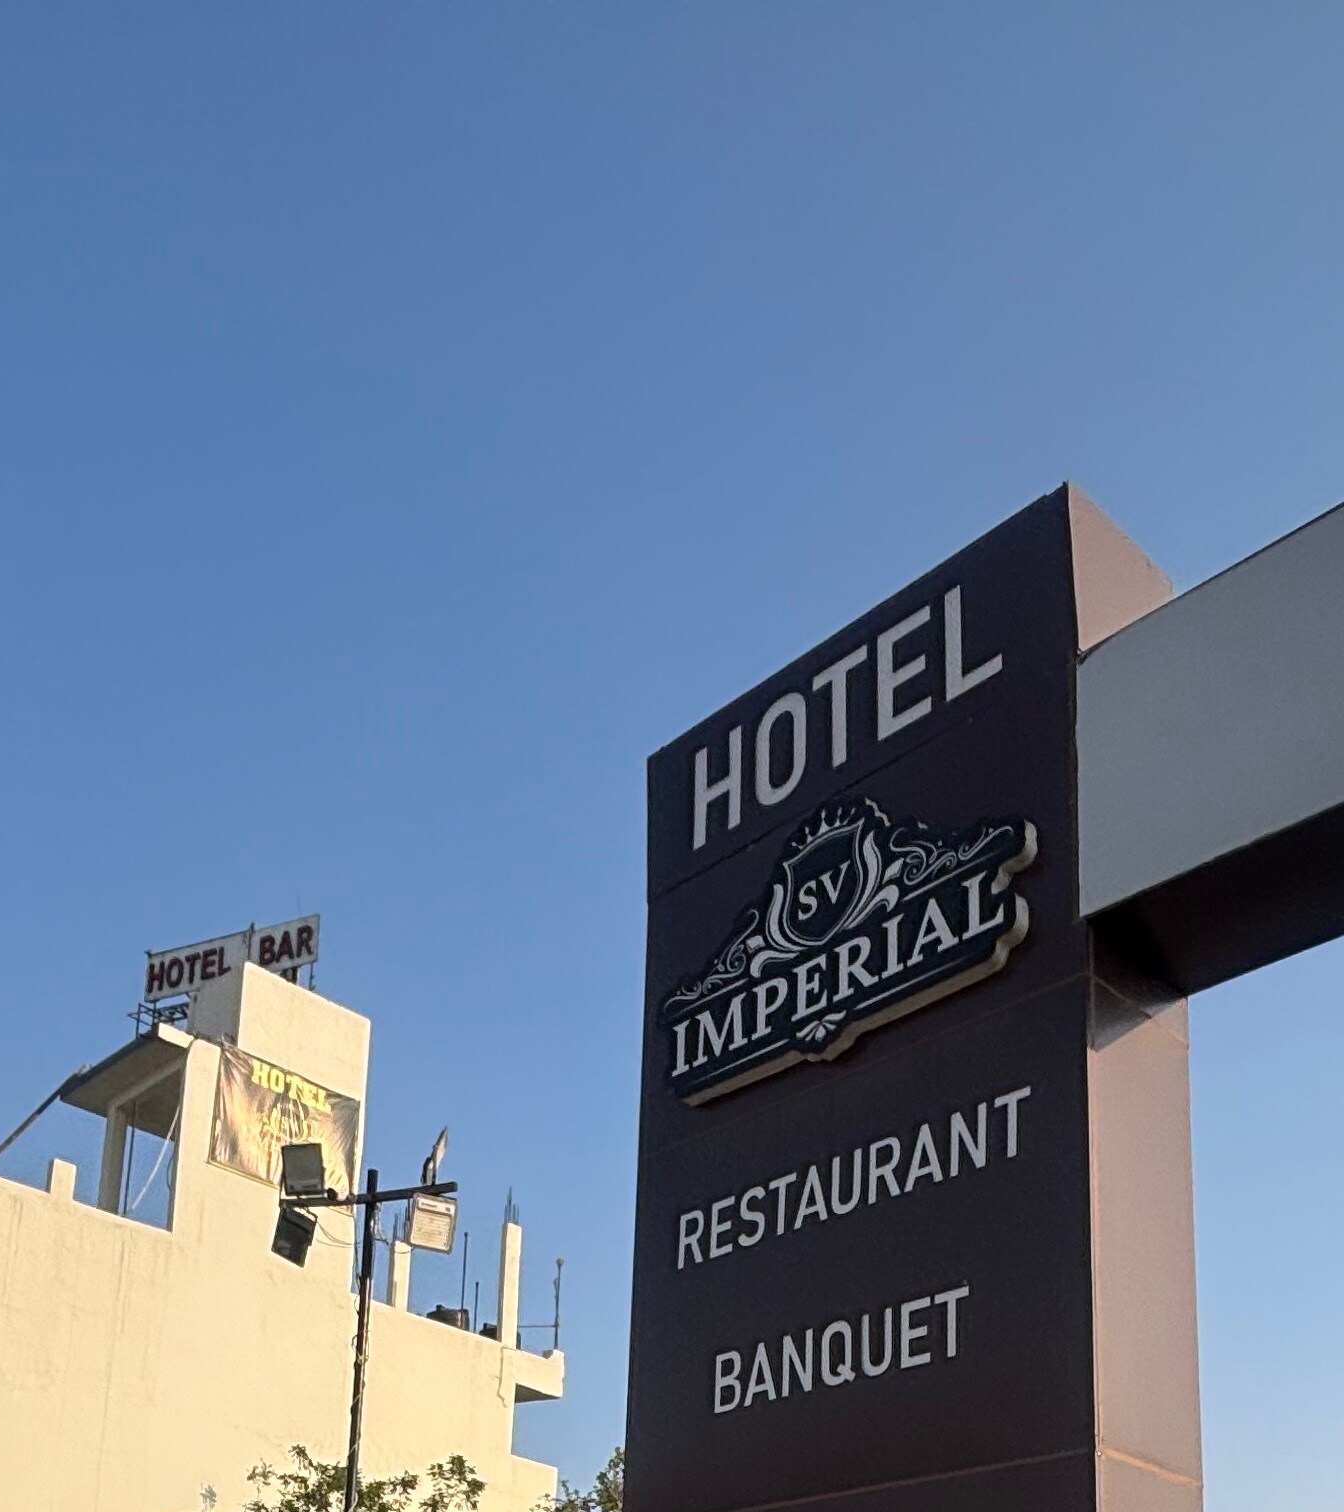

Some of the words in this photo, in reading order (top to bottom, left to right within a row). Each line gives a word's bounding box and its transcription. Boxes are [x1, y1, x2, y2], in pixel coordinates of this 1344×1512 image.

[692, 584, 1004, 851] HOTEL
[798, 862, 852, 923] SV
[145, 946, 231, 994] HOTEL
[259, 924, 314, 966] BAR
[670, 870, 1005, 1077] IMPERIAL
[250, 1059, 332, 1115] HOTEL
[676, 1085, 1032, 1270] RESTAURANT
[713, 1285, 970, 1414] BANQUET
